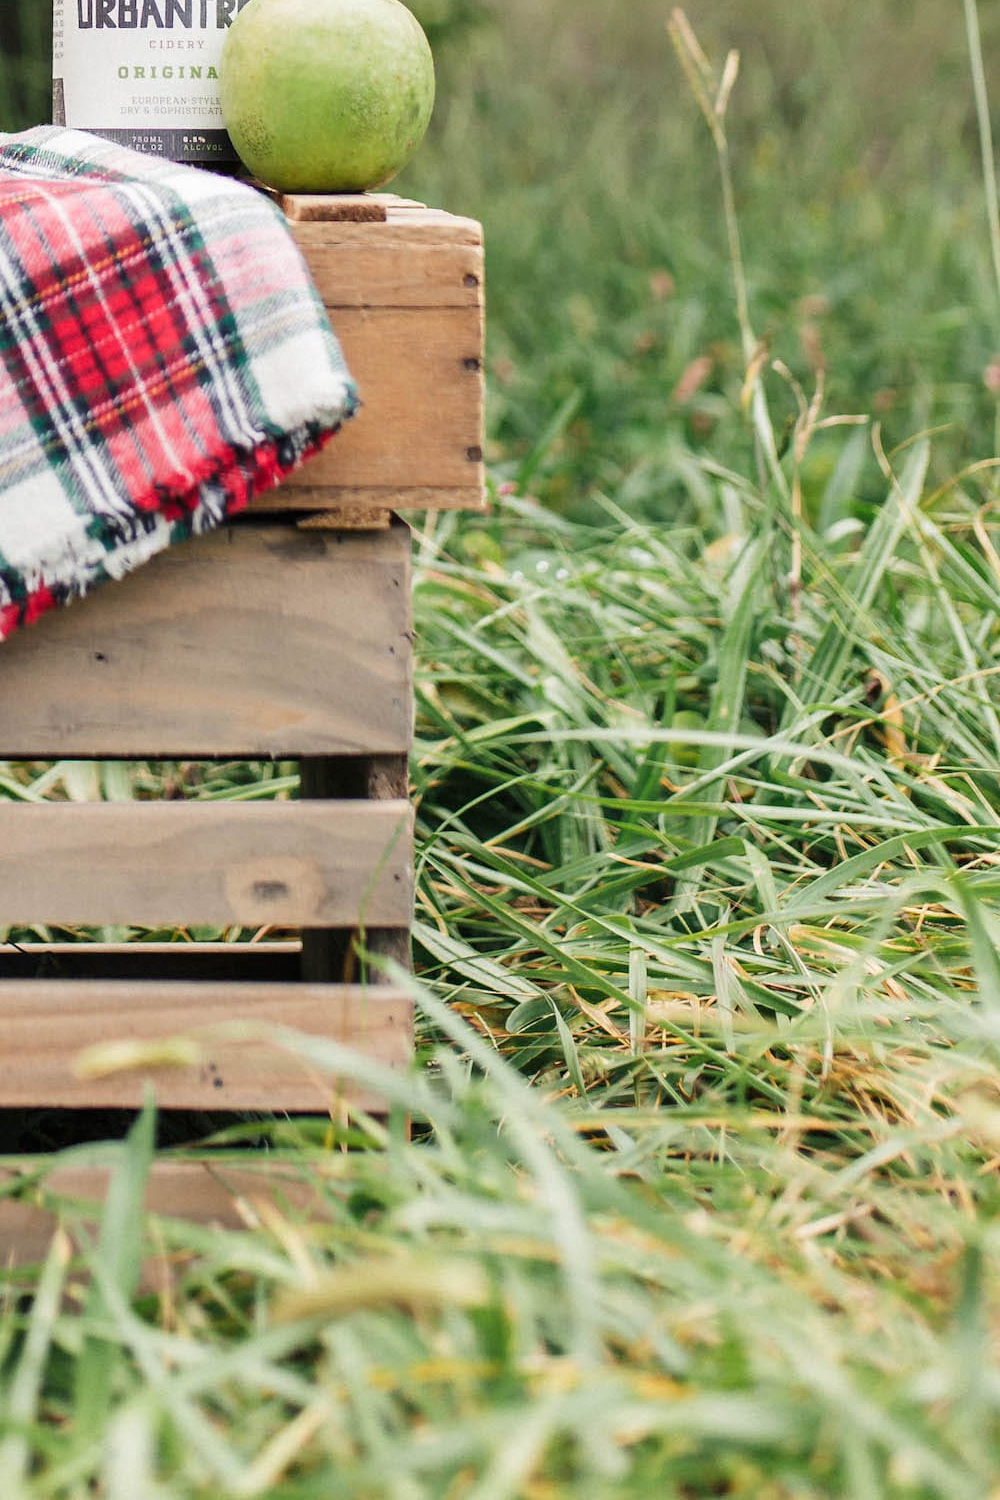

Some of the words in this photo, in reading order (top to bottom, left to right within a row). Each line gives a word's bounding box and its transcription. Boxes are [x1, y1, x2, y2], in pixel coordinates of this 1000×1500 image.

[149, 40, 205, 49] CIDERY
[117, 65, 219, 79] ORIGINA
[120, 106, 140, 115] DRY
[183, 143, 223, 151] ALC/VOL
